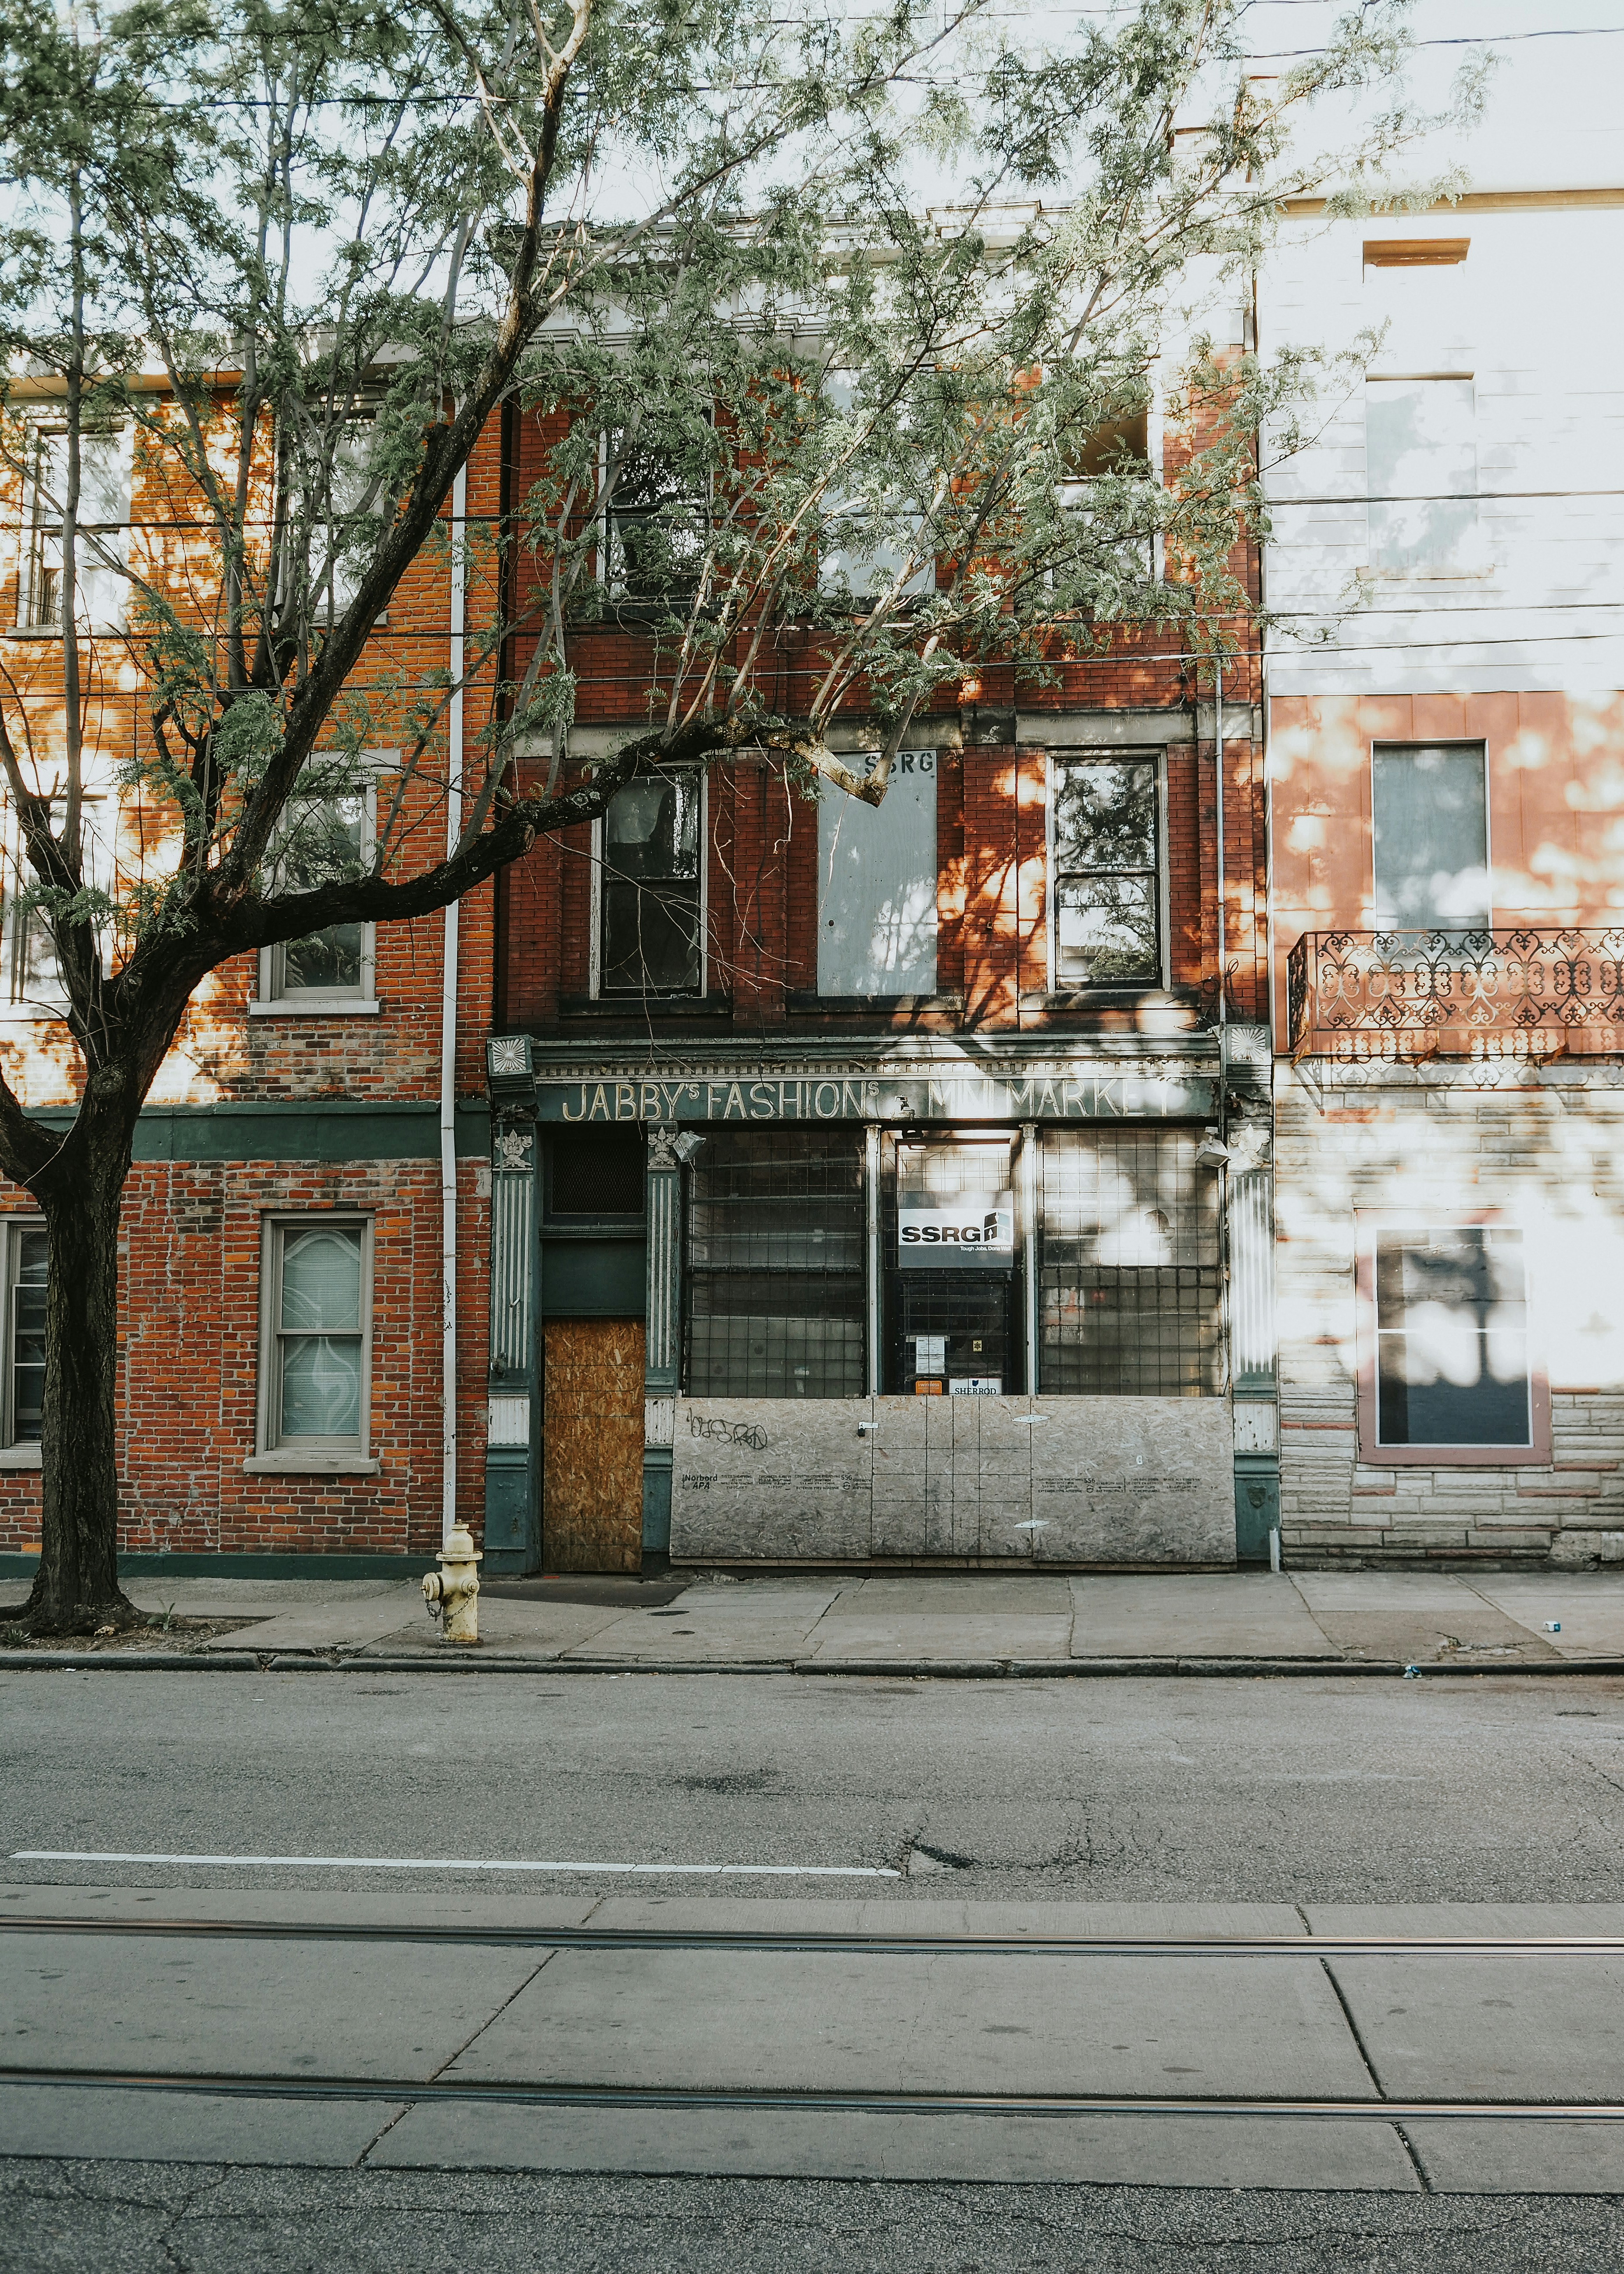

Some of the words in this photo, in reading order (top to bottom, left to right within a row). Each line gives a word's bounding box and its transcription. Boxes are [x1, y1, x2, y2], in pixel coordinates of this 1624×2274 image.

[864, 752, 933, 774] SRG
[902, 1226, 981, 1242] SSRG
[692, 1481, 710, 1490] APA
